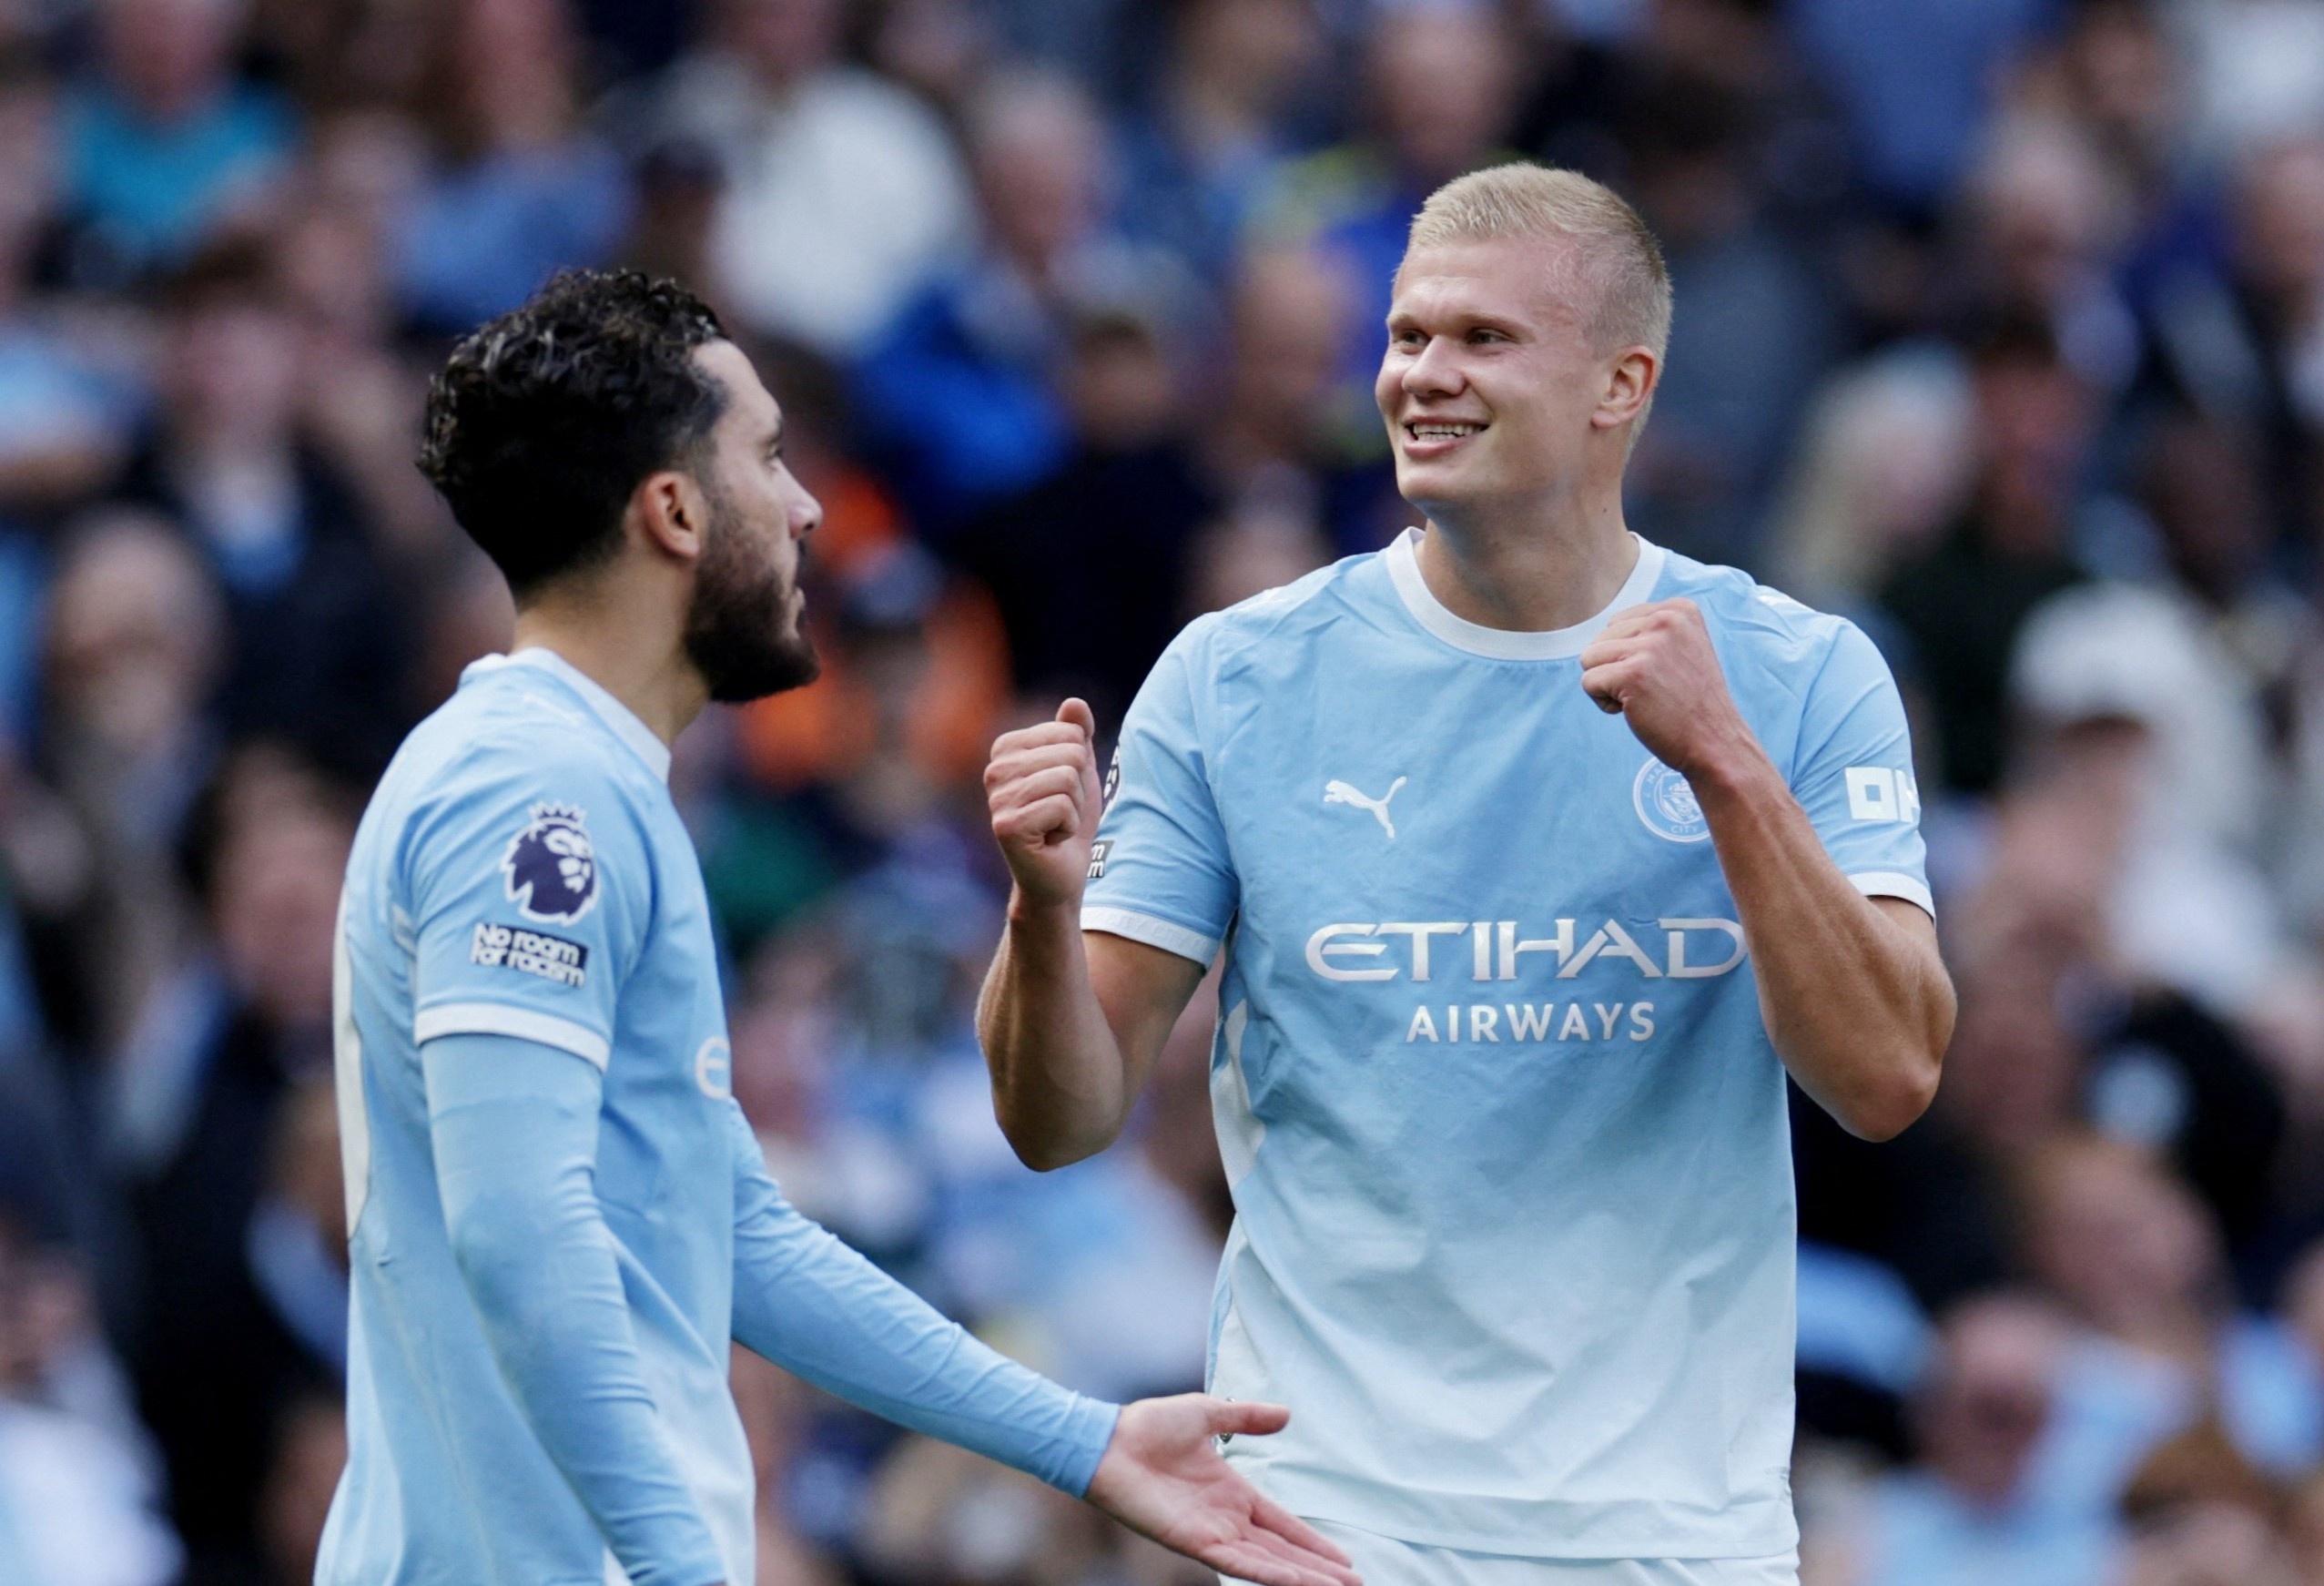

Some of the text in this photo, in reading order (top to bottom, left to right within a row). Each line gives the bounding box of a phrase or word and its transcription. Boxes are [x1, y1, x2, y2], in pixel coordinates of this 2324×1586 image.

[1670, 825, 1699, 834] CITY
[470, 944, 507, 966] for
[472, 921, 580, 967] No room
[1304, 918, 1749, 981] ETIHAD
[1406, 1001, 1655, 1042] AIRWAYS
